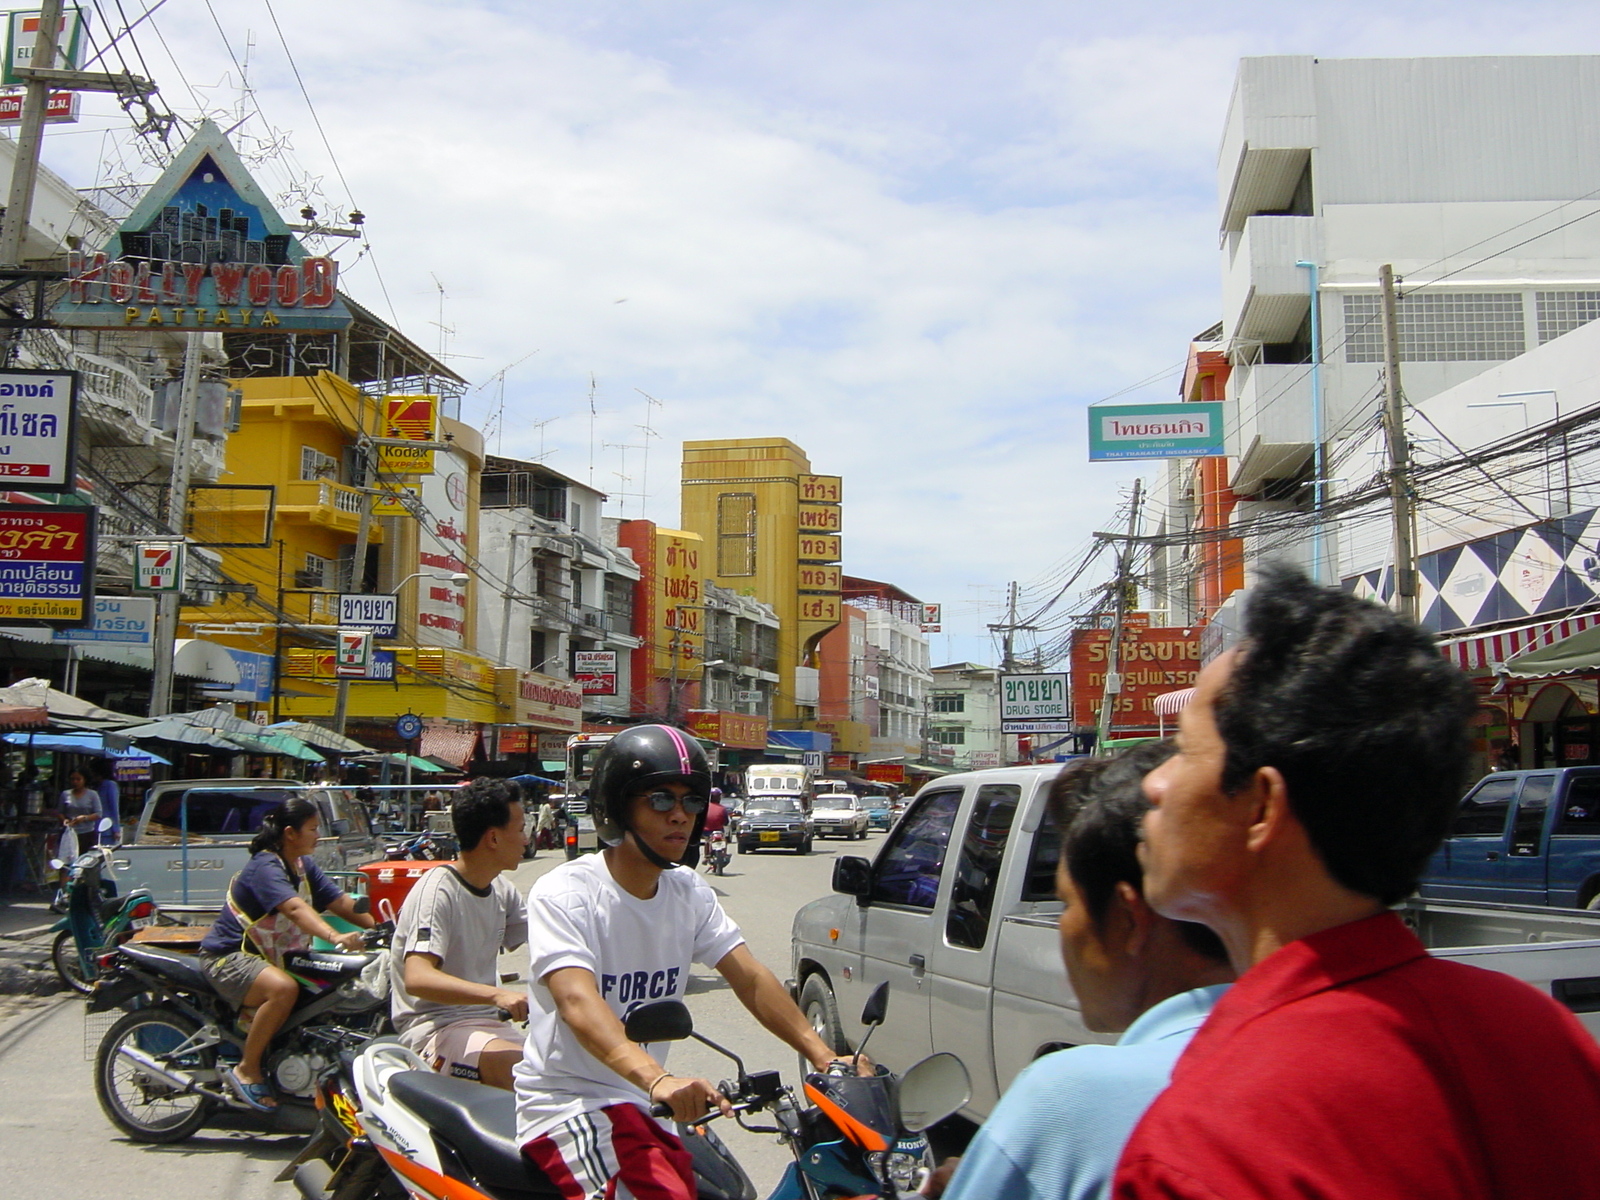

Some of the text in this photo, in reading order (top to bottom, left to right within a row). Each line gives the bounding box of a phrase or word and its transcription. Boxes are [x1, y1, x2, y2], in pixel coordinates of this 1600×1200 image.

[68, 251, 336, 309] HOLLYWOOD
[125, 306, 280, 327] PATTAYA
[1109, 420, 1204, 436] ไทยธนกิจ
[385, 445, 428, 458] Kodak
[802, 476, 837, 499] ห้าง
[800, 508, 838, 528] เพชร
[666, 538, 698, 570] ห้าง
[801, 540, 838, 556] ทอง
[664, 574, 699, 601] เพชร
[801, 570, 838, 586] ทอง
[343, 599, 394, 621] ขายยา
[1005, 679, 1063, 702] ขายยา
[1006, 704, 1062, 715] DRUG STORE
[167, 859, 225, 872] ISUZU
[291, 956, 344, 972] Kawasaki
[601, 966, 680, 1004] FORCE
[389, 1126, 410, 1148] HONDA
